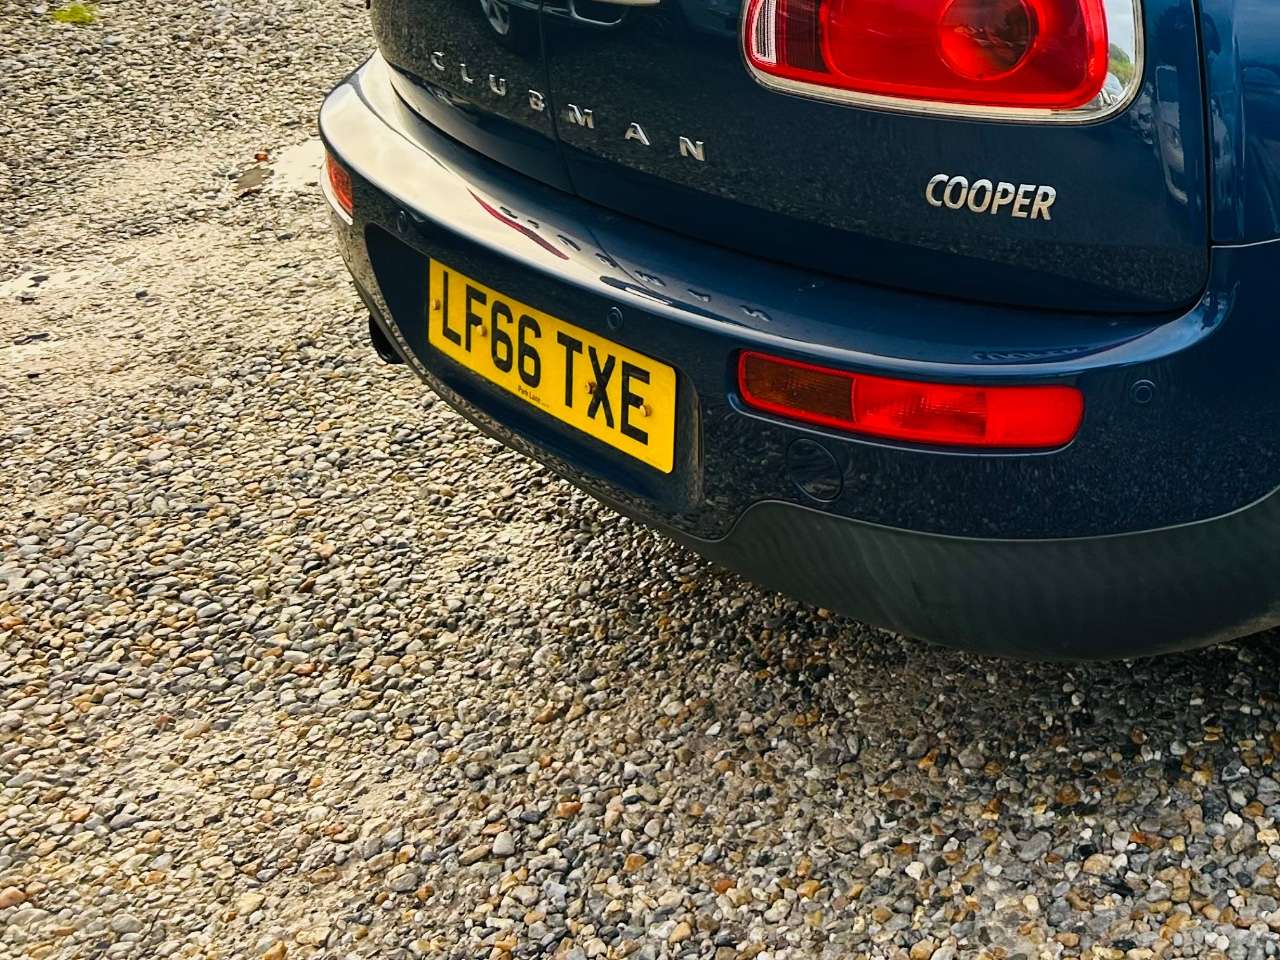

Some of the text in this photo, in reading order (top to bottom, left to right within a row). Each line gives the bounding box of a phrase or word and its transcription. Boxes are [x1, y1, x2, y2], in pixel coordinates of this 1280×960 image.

[430, 51, 706, 162] CLUBMAN
[925, 173, 1057, 221] COOPER
[442, 270, 651, 447] LF66 TXE
